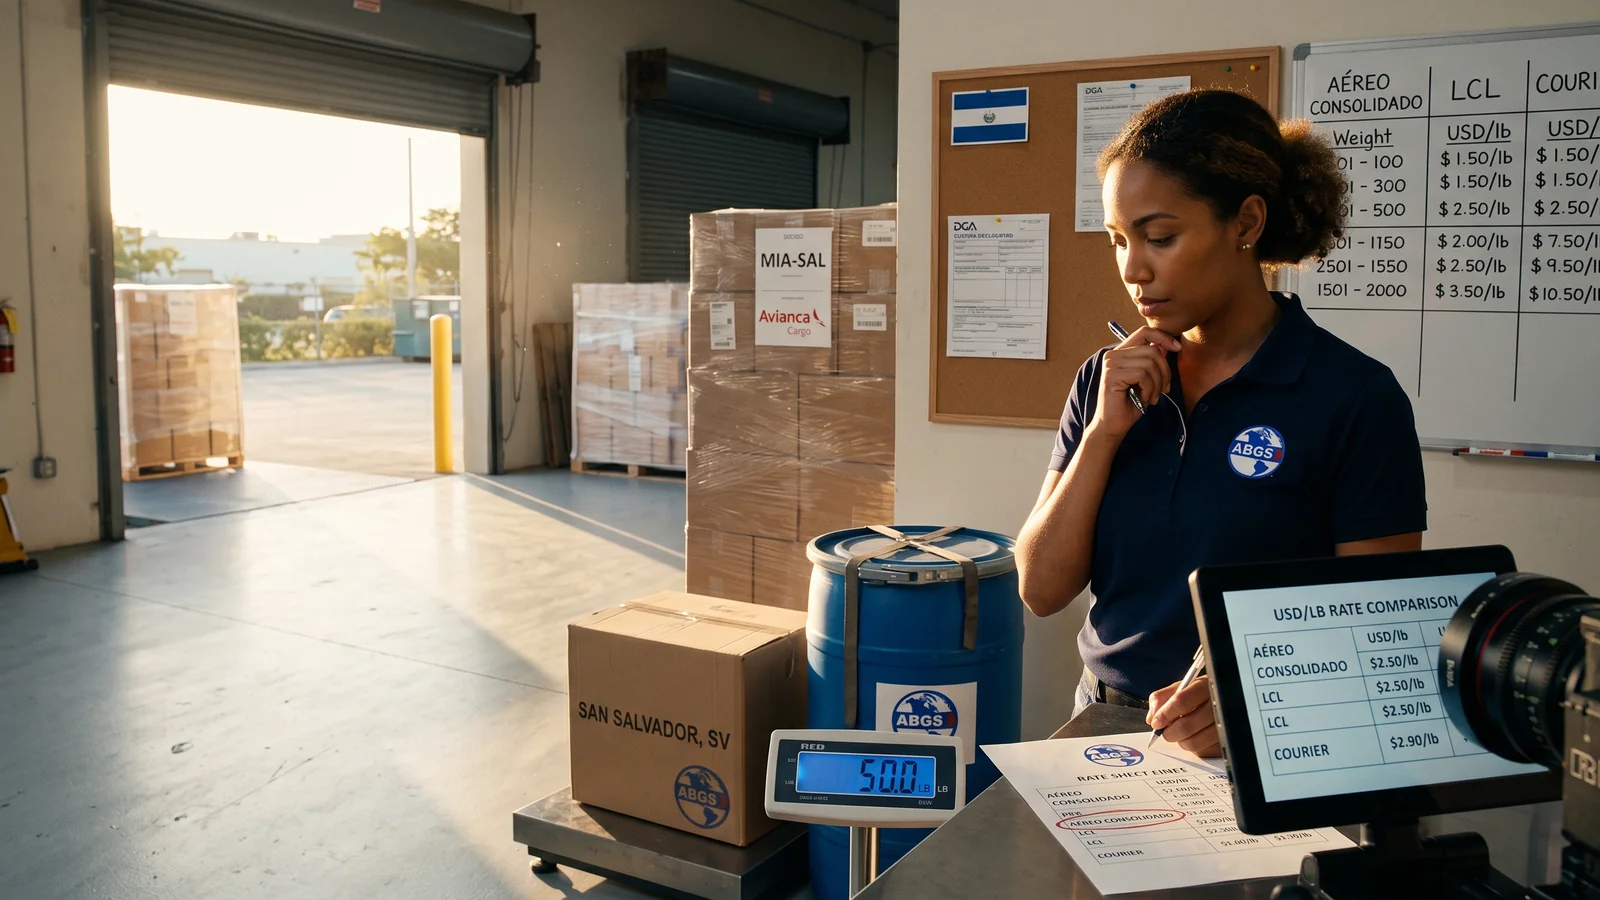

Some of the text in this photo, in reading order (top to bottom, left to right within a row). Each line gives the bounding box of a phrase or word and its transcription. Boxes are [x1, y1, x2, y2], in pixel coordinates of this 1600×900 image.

[1327, 69, 1391, 94] AÉREO
[1451, 78, 1501, 101] LCL
[1535, 71, 1599, 94] COURI
[1085, 87, 1103, 95] DGA
[1309, 94, 1423, 116] CONSOLIDADO
[1447, 119, 1512, 143] USD/lb
[1333, 127, 1393, 152] Weight
[1374, 154, 1404, 169] 100
[1373, 178, 1406, 194] 300
[1373, 202, 1406, 217] 500
[954, 221, 977, 231] DGA
[760, 252, 826, 268] MIA-SAL
[1316, 259, 1351, 273] 2501
[1371, 259, 1408, 273] 1550
[1318, 283, 1347, 297] 1501
[1366, 283, 1407, 297] 2000
[759, 309, 811, 324] Avianca
[787, 326, 812, 337] Cargo
[1231, 442, 1274, 459] ABGS
[1273, 605, 1327, 622] USD/LB
[1329, 603, 1364, 618] RATE
[1366, 594, 1459, 615] COMPARISON
[1367, 629, 1409, 646] USD/lb
[1253, 643, 1295, 659] AÉREO
[1370, 653, 1419, 670] $2.50/lb
[1256, 660, 1348, 680] CONSOLIDADO
[1376, 677, 1425, 695] $2.50/lb
[1262, 691, 1284, 704] LCL
[1382, 701, 1432, 719] $2.50/lb
[578, 701, 731, 750] SAN SALVADOR, SV
[896, 714, 943, 727] ABGS
[1267, 716, 1289, 729] LCL
[1389, 731, 1440, 750] $2.90/lb
[1274, 744, 1330, 761] COURIER
[859, 758, 931, 794] 50.0 LB
[1077, 774, 1110, 782] RATE
[677, 786, 717, 806] ABGS
[937, 785, 949, 793] LB
[1047, 790, 1082, 798] AÉREO
[1052, 794, 1131, 806] CONSOLIDADO
[1104, 812, 1174, 824] CONSOLIDADO
[1097, 849, 1144, 859] COURIER
